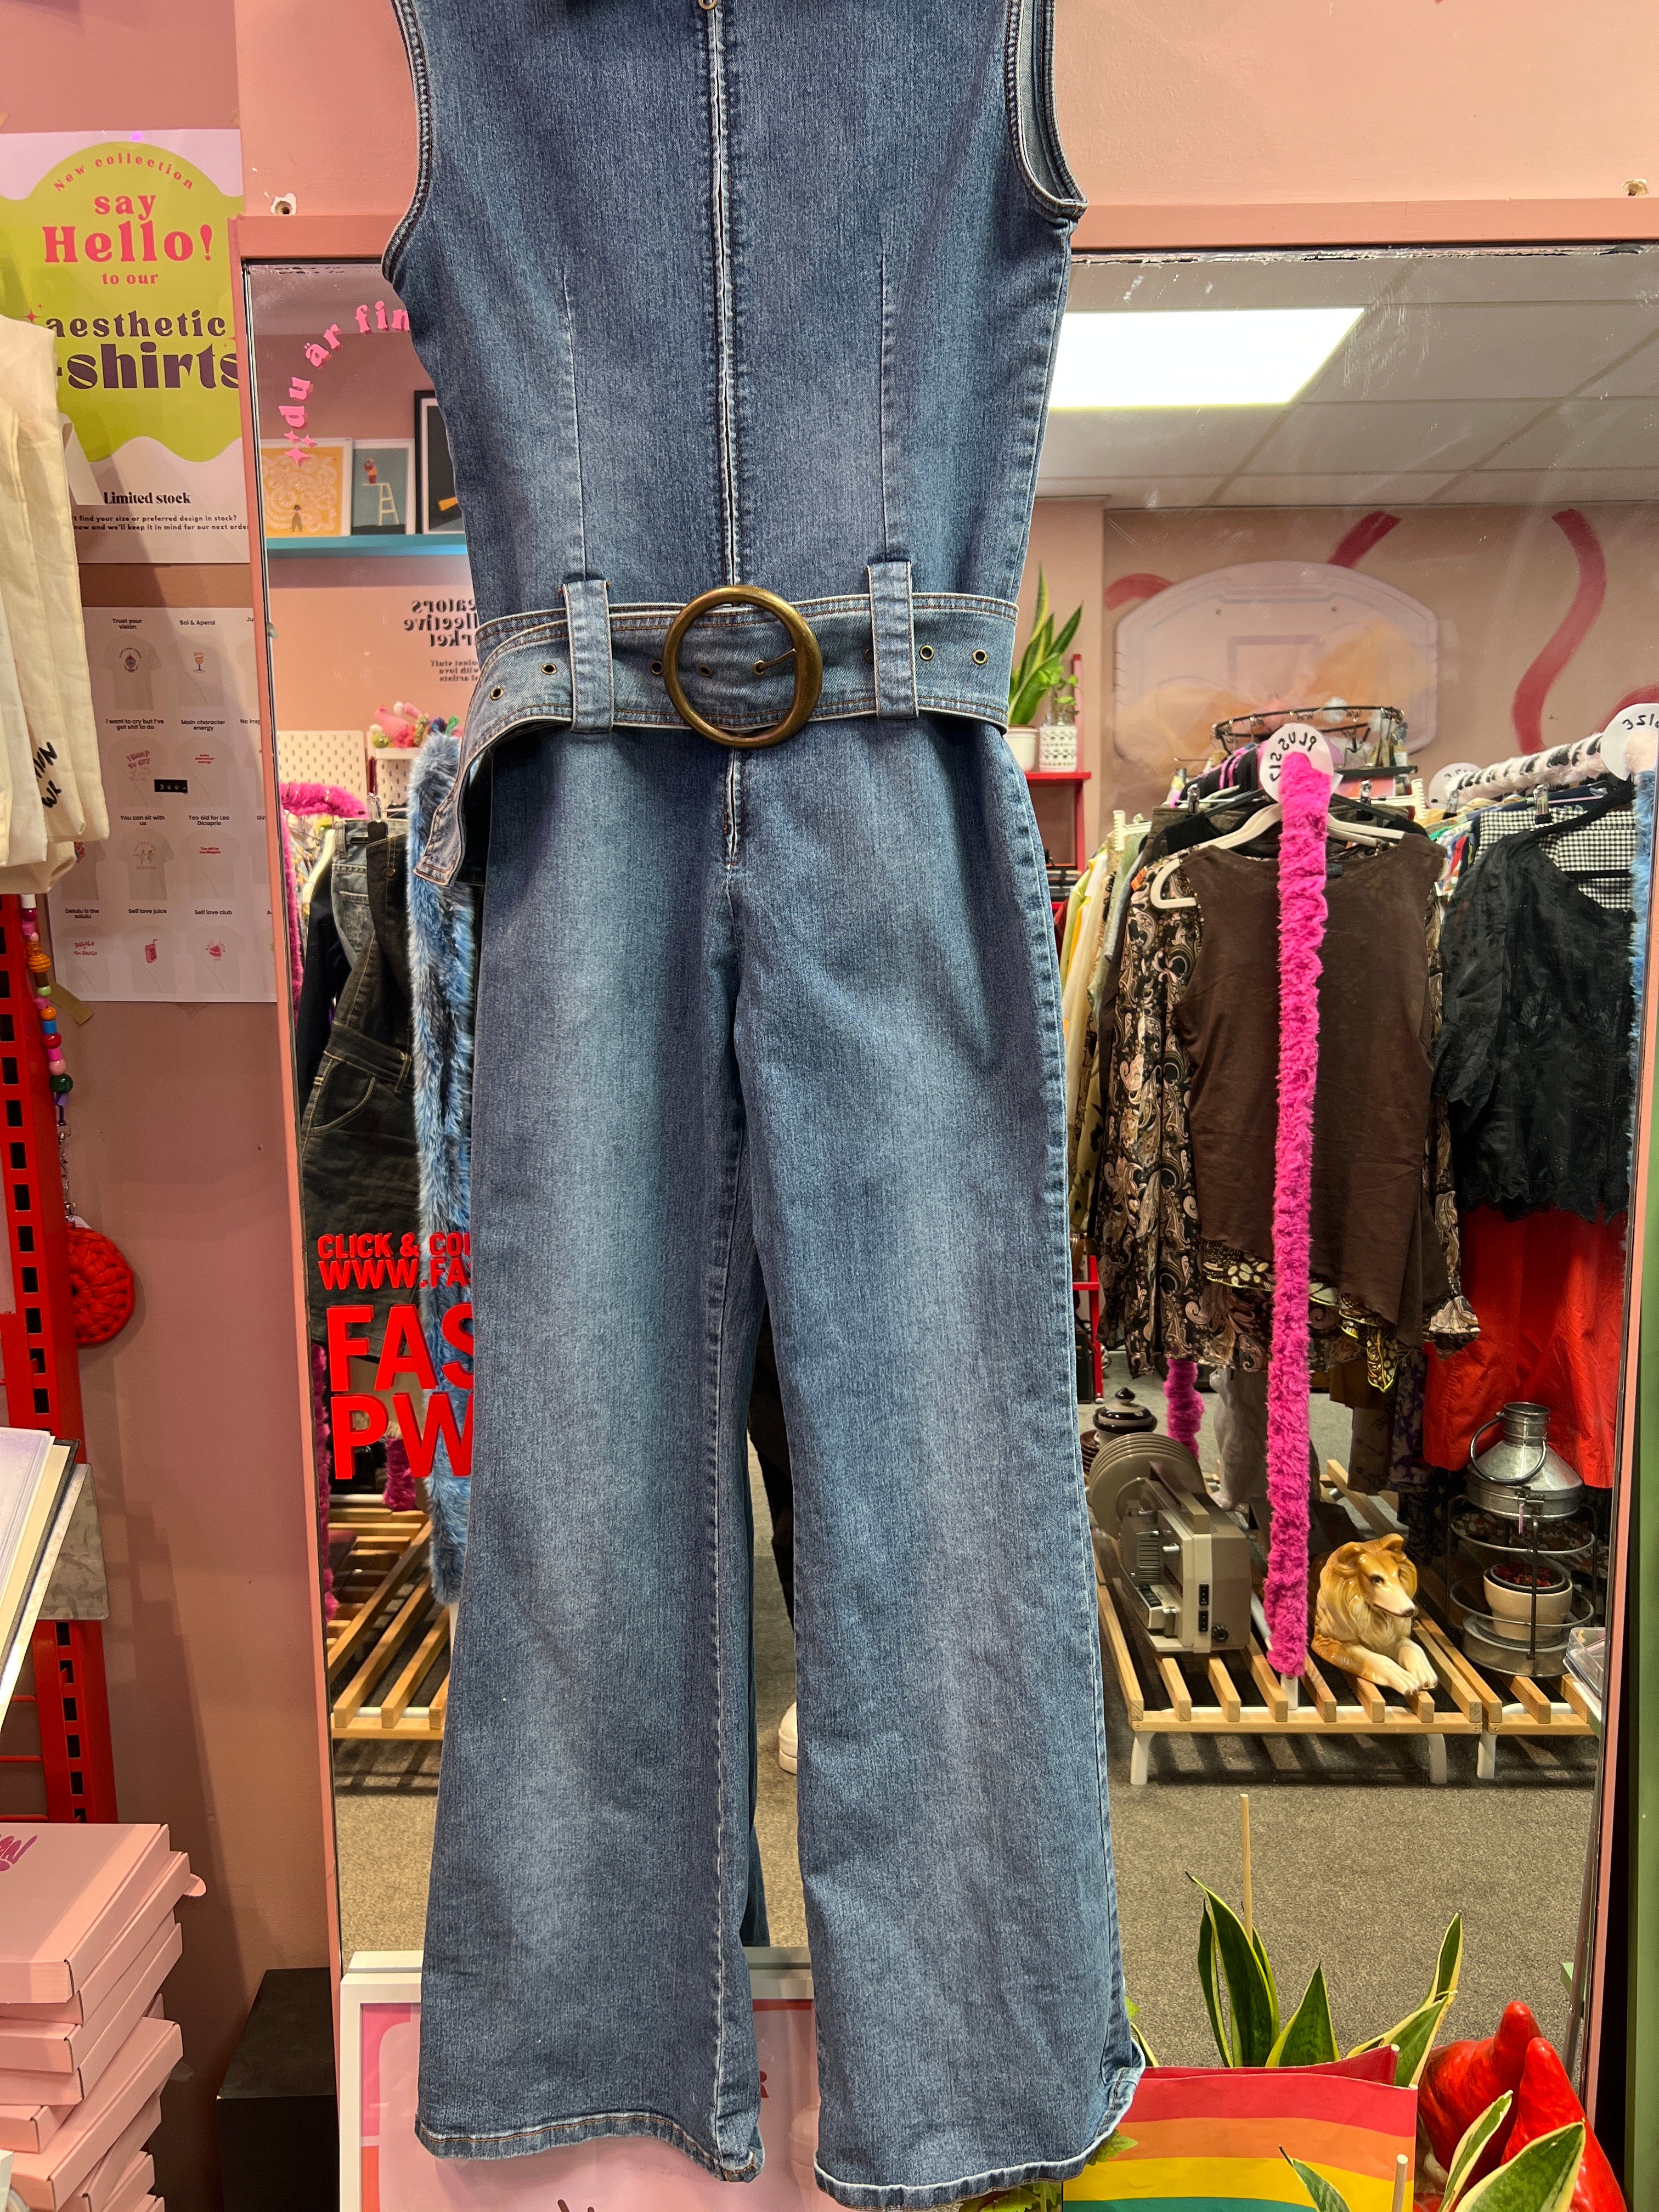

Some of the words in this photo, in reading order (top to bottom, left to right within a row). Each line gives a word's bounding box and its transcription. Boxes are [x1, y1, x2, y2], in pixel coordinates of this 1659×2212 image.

[54, 165, 84, 191] New
[95, 153, 193, 189] collection
[94, 195, 156, 221] say
[42, 220, 212, 263] Hello!
[102, 273, 119, 285] to
[126, 274, 158, 285] our
[46, 309, 226, 337] aesthetic
[103, 492, 153, 504] Limited
[156, 492, 191, 504] stock
[317, 1233, 391, 1259] CLICK
[399, 1232, 420, 1257] &
[318, 1258, 471, 1290] WWW.FA
